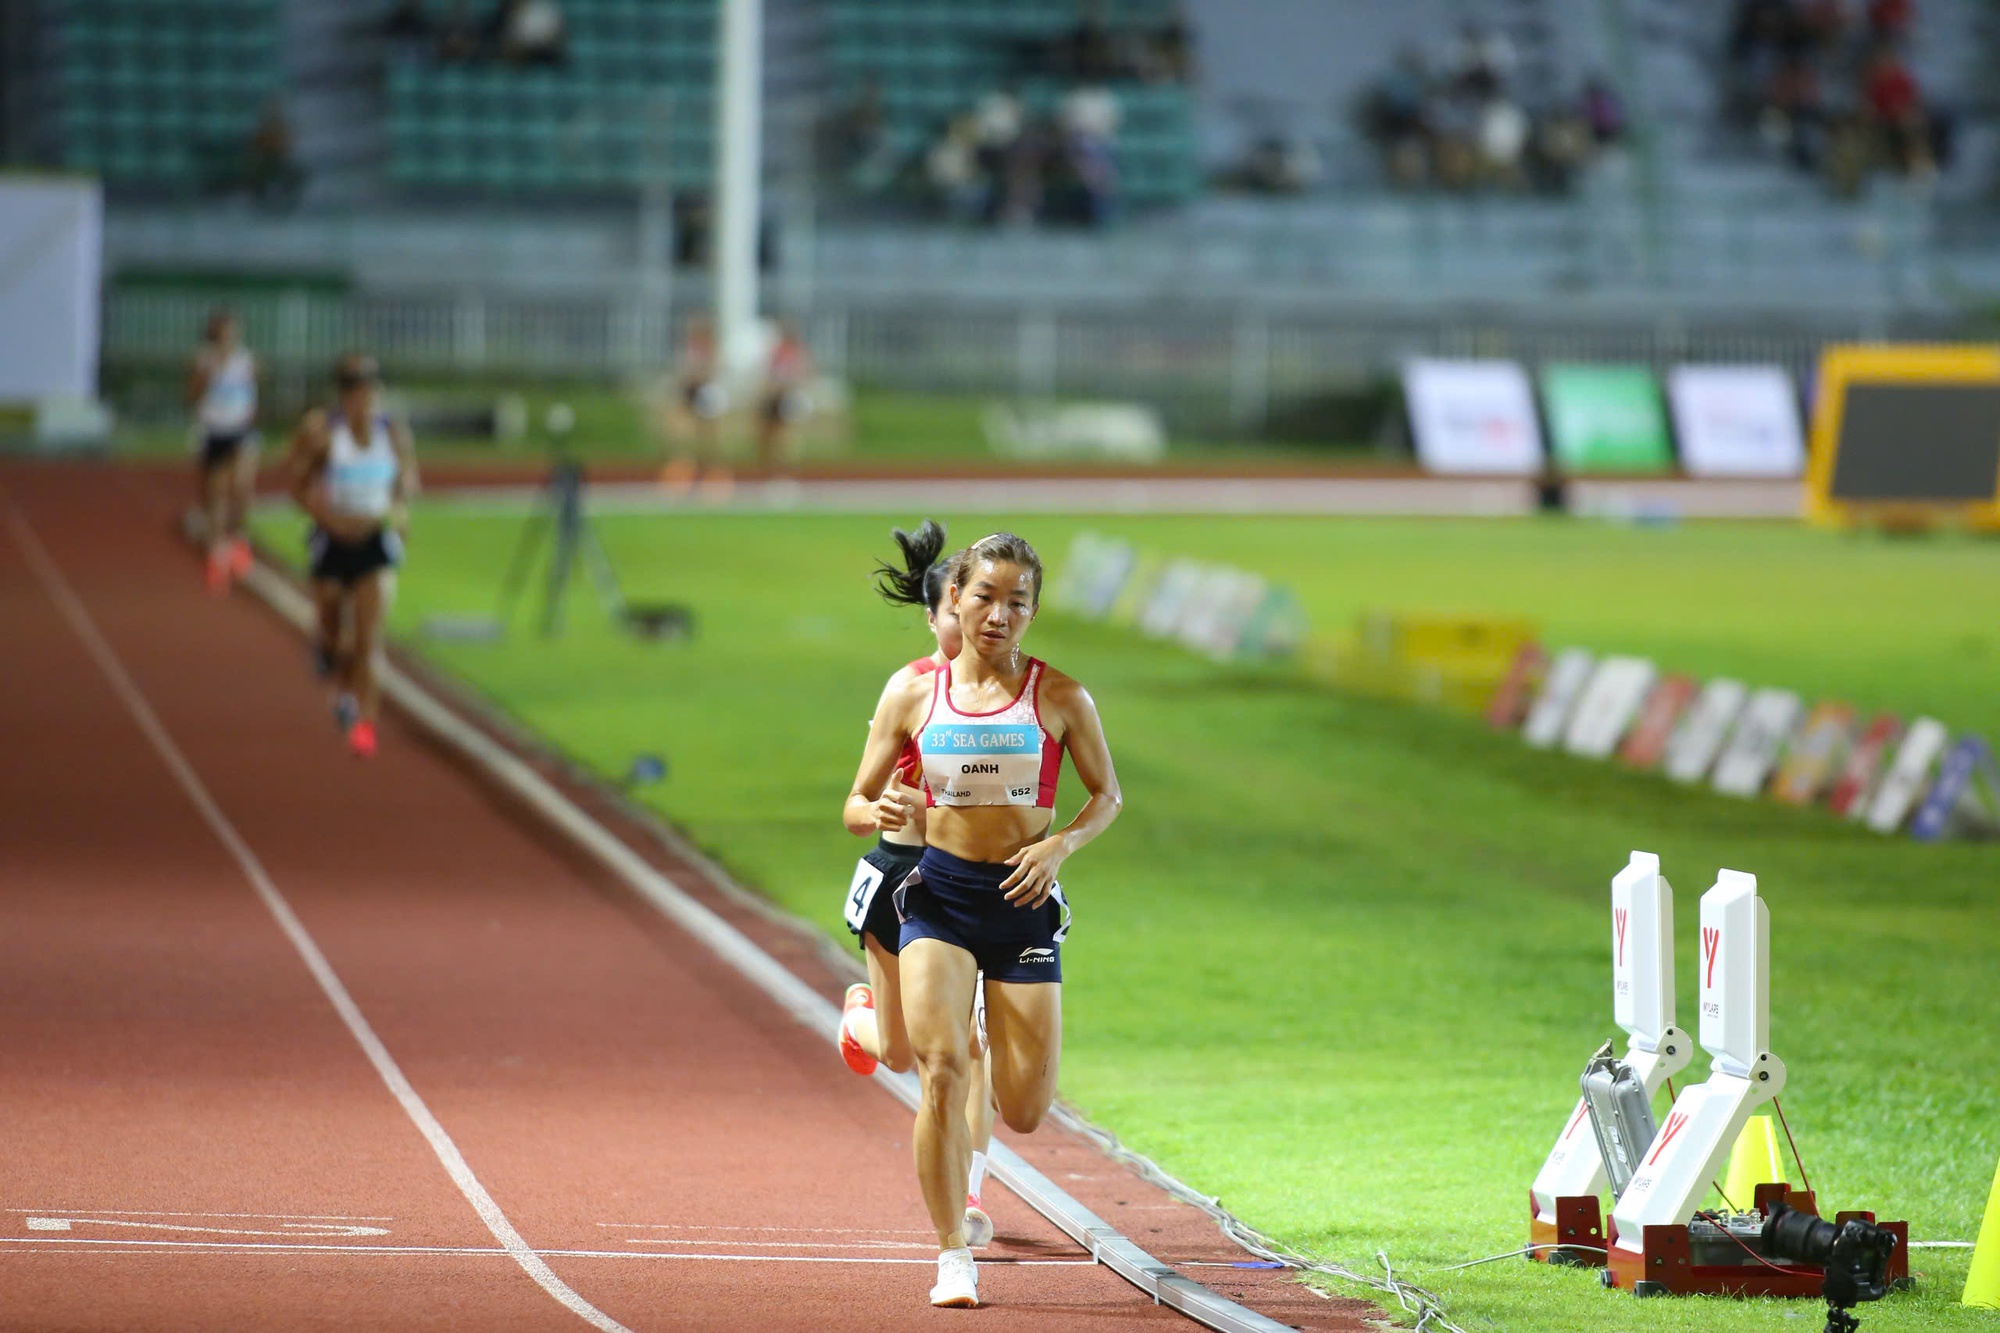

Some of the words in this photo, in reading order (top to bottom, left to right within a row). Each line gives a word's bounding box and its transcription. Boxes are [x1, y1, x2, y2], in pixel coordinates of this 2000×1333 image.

[931, 729, 952, 747] 33rd
[953, 733, 976, 747] SEA
[980, 733, 1025, 747] GAMES
[961, 764, 999, 774] OANH
[941, 788, 971, 797] THAILAND
[1011, 787, 1031, 797] 652
[852, 876, 872, 916] 4
[1019, 956, 1055, 964] LI-NING
